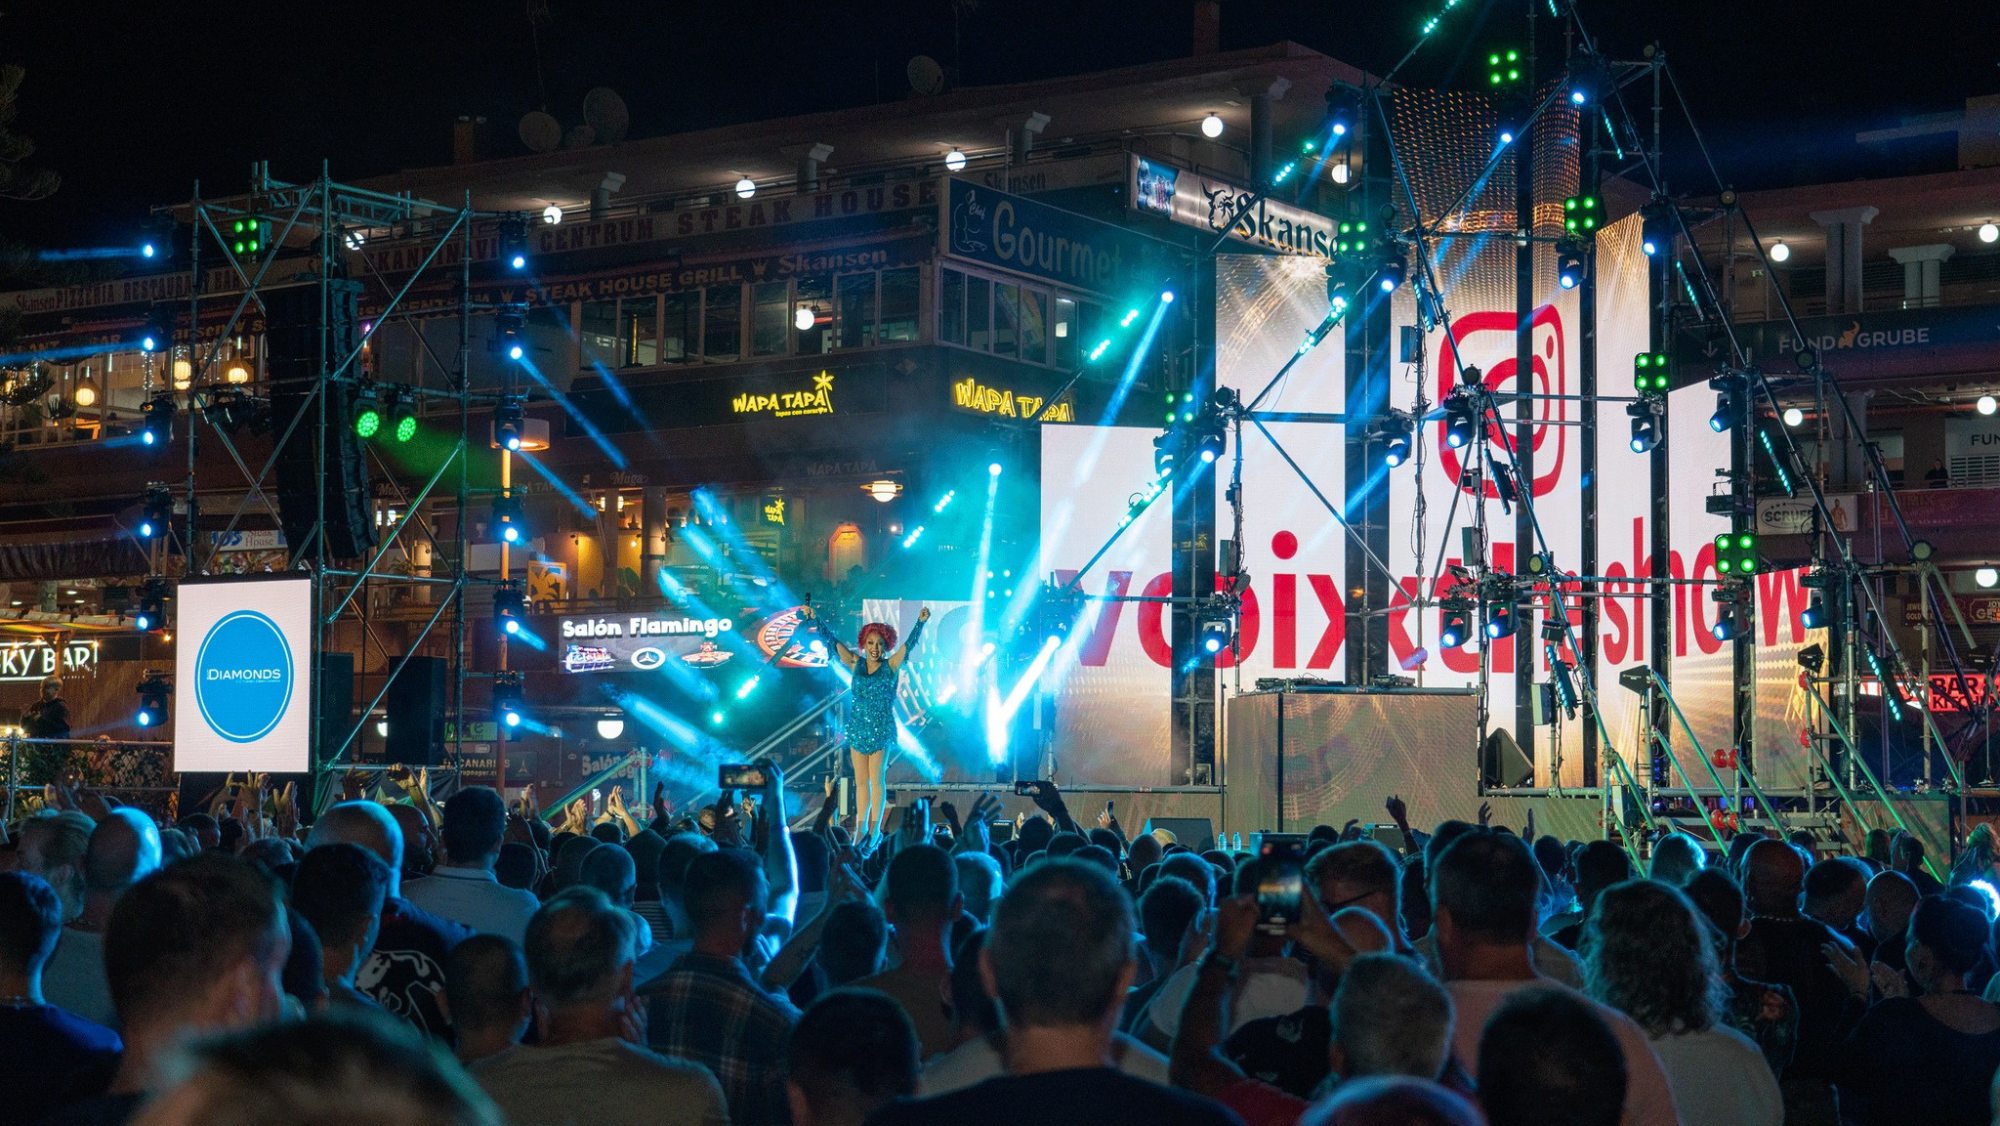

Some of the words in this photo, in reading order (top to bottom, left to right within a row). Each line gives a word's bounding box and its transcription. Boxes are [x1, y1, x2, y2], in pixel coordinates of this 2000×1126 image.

[541, 217, 653, 252] CENTRUM
[677, 199, 792, 235] STEAK
[814, 180, 938, 218] HOUSE
[1235, 192, 1339, 259] Skanse
[993, 200, 1123, 283] Gourmet
[525, 283, 592, 302] STEAK
[600, 273, 672, 293] HOUSE
[679, 265, 743, 287] GRILL
[778, 249, 887, 275] Skansen
[1857, 327, 1930, 348] GRUBE
[732, 392, 780, 413] WAPA
[781, 389, 827, 409] TAPA
[955, 377, 1017, 418] WAPA
[609, 471, 649, 486] Muga
[807, 461, 842, 476] WAPA
[844, 459, 878, 472] TAPA
[245, 537, 274, 548] House
[562, 619, 622, 639] Salón
[630, 617, 732, 639] Flamingo
[0, 648, 36, 677] KY
[42, 646, 93, 674] BAR
[1932, 677, 1979, 695] BAR
[460, 758, 511, 769] CANARIS
